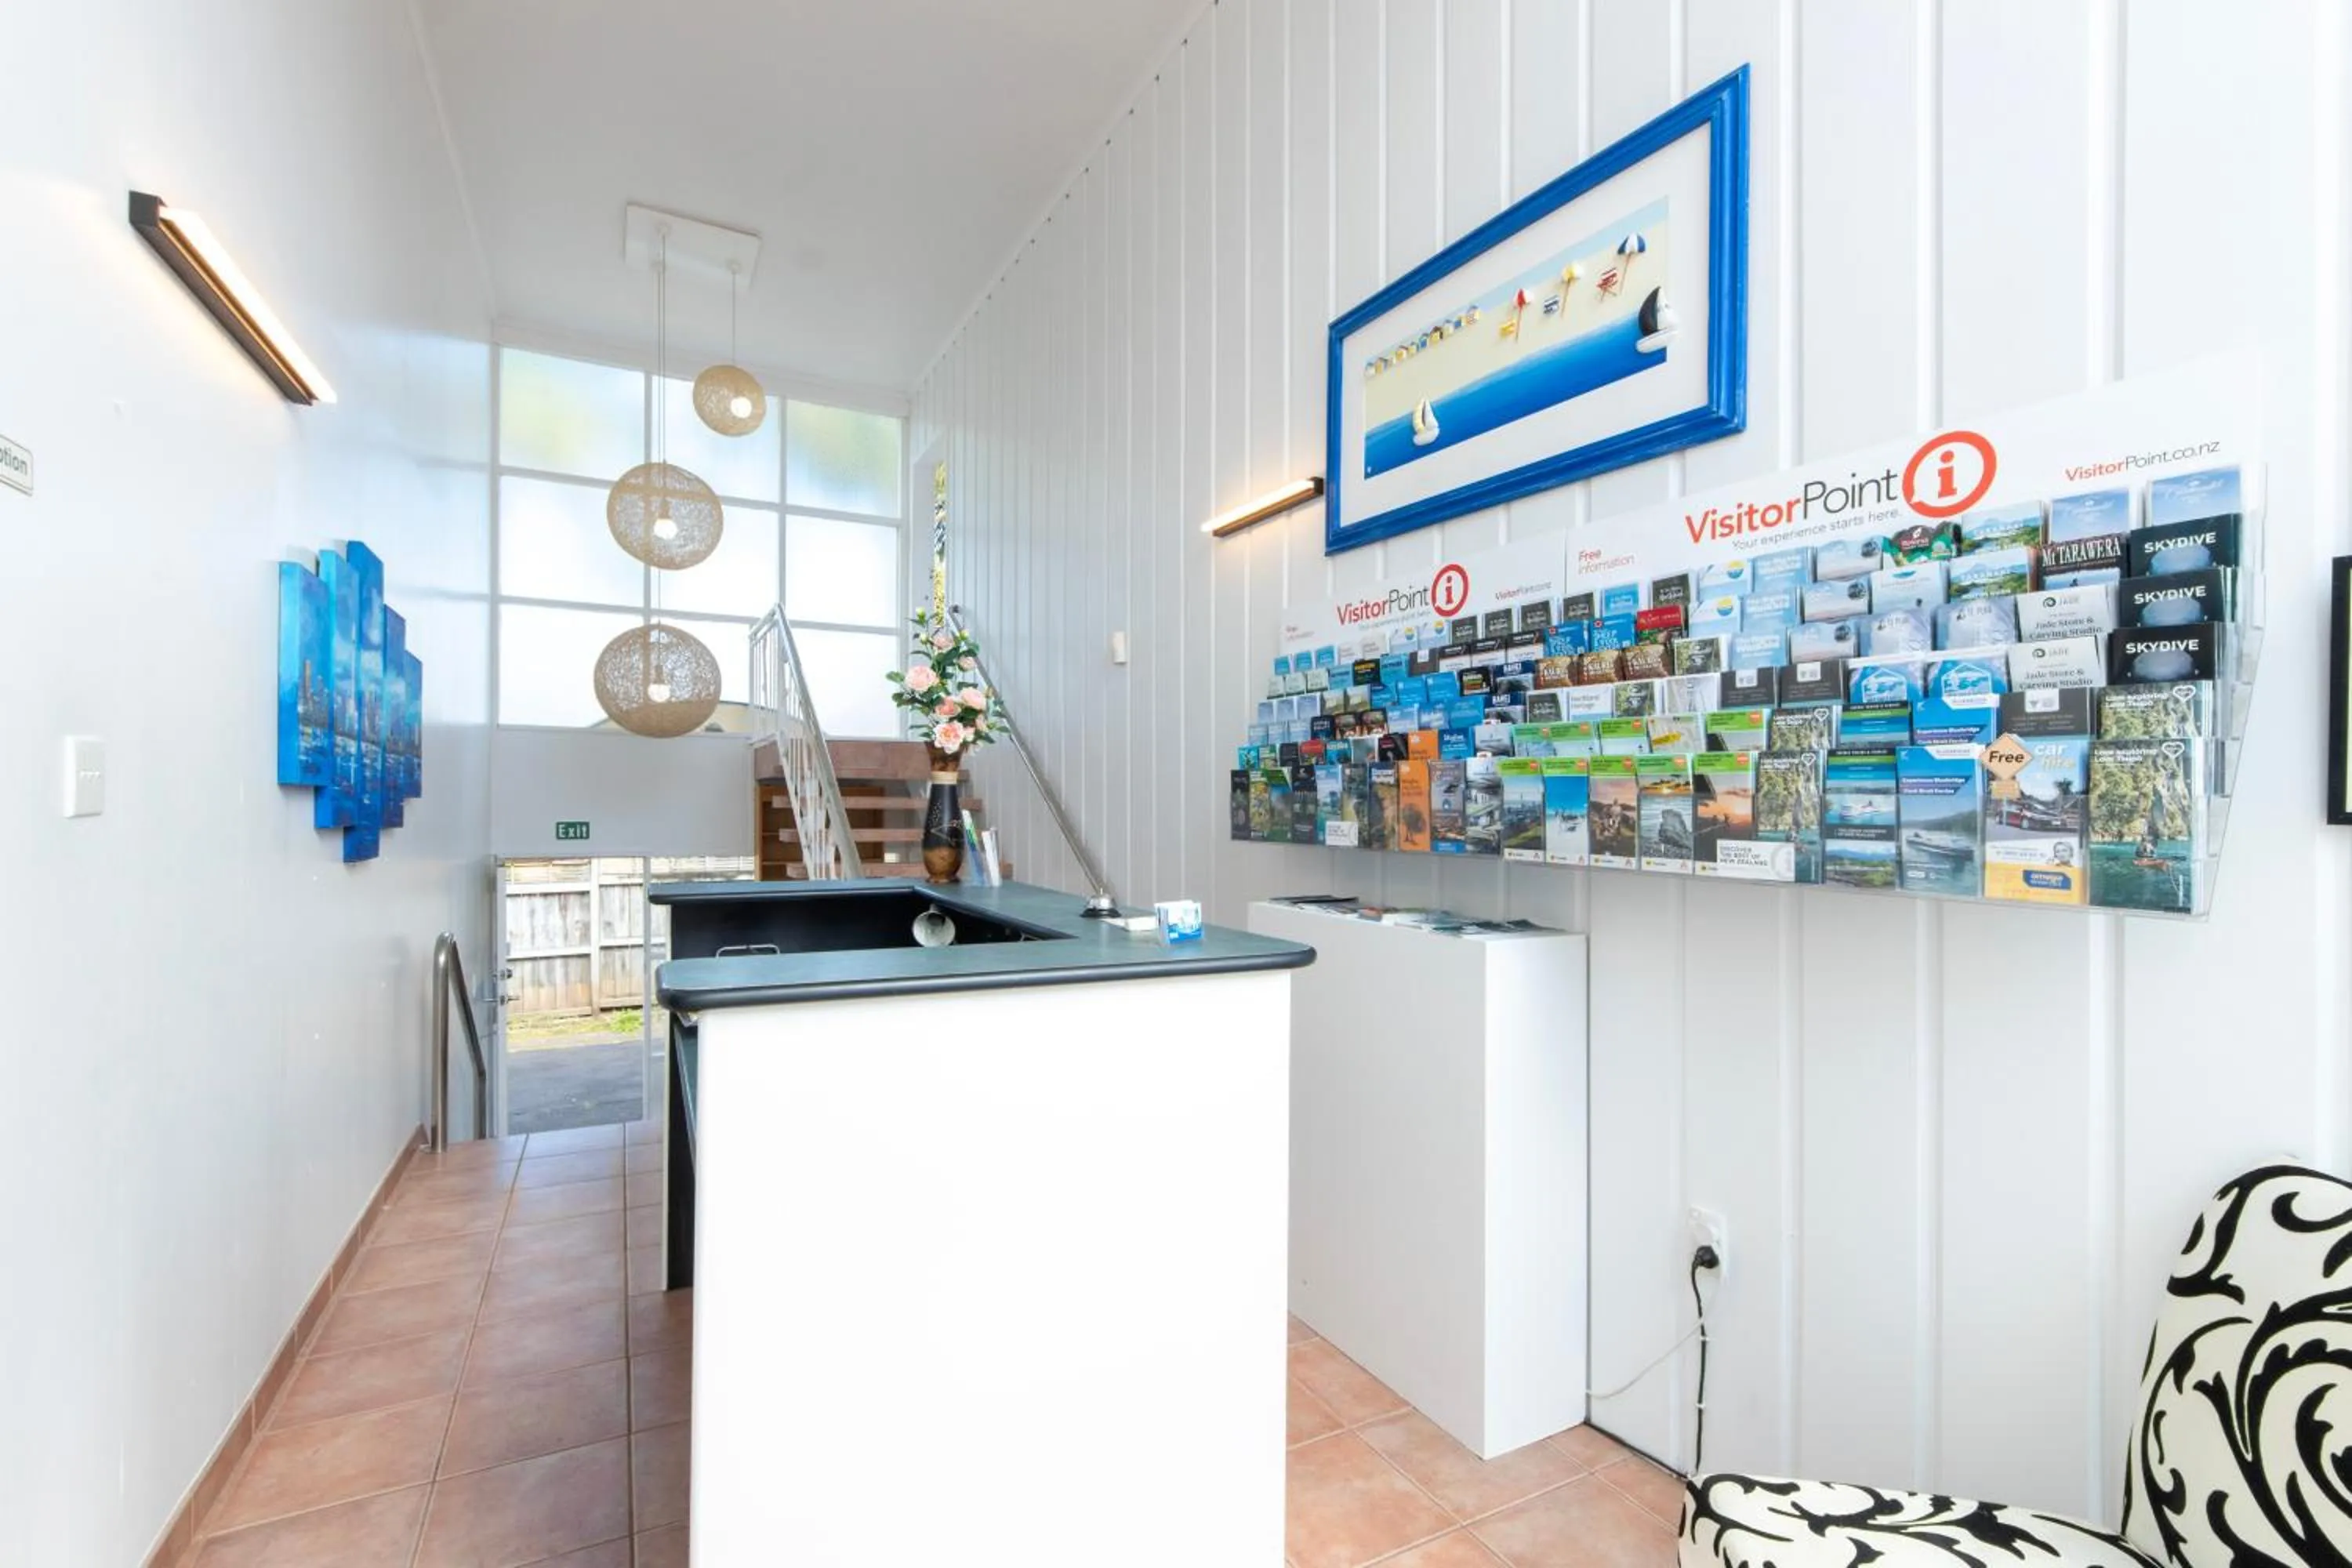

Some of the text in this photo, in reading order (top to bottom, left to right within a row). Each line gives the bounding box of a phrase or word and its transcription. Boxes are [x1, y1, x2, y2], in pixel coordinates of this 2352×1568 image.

[2065, 439, 2220, 482] VisitorPoint.co.nz
[1686, 469, 1899, 543] VisitorPoint
[1733, 535, 1759, 551] Your
[1760, 523, 1827, 547] experience
[1829, 514, 1865, 532] starts
[2144, 532, 2216, 554] SKYDIVE
[1579, 550, 1602, 561] Free
[2057, 537, 2122, 564] TARAWERA
[1337, 585, 1429, 626] VisitorPoint
[2133, 585, 2207, 605] SKYDIVE
[2125, 639, 2199, 654] SKYDIVE
[1989, 750, 2024, 763] Free
[2034, 744, 2065, 755] car
[558, 824, 587, 838] Exit
